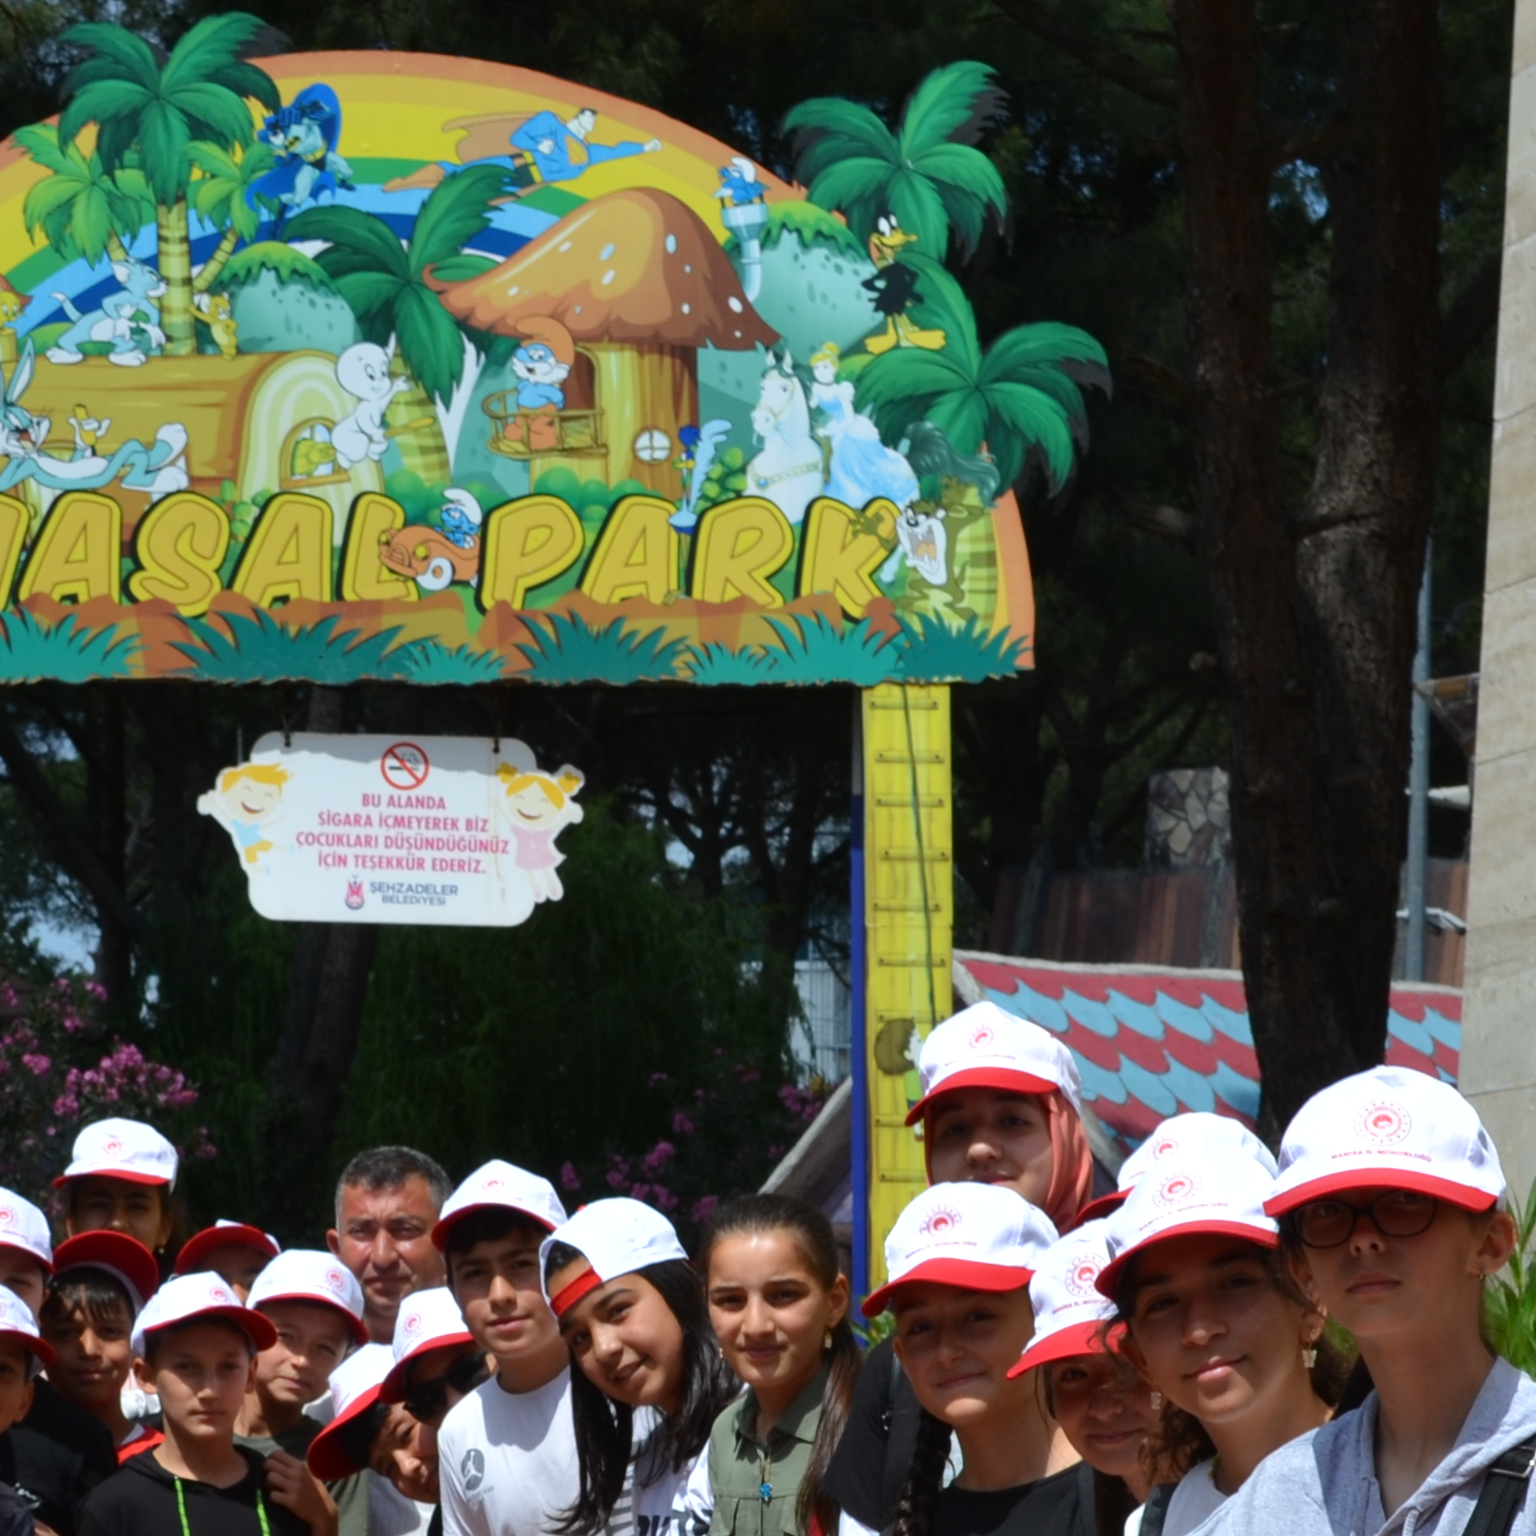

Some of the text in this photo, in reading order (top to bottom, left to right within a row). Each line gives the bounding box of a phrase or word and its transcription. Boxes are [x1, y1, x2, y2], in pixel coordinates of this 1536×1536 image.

[479, 493, 896, 618] PARK
[362, 793, 446, 810] BU ALANDA
[318, 810, 489, 832] SİGARA İÇMEYEREK BİZ
[296, 831, 510, 855] ÇOCUKLARI DÜŞÜNDÜĞÜNÜZ
[318, 852, 487, 874] İÇİN TEŞEKKÜR EDERİZ.
[370, 881, 459, 897] ŞEHZADELER
[381, 894, 447, 907] BELEDİYESİ
